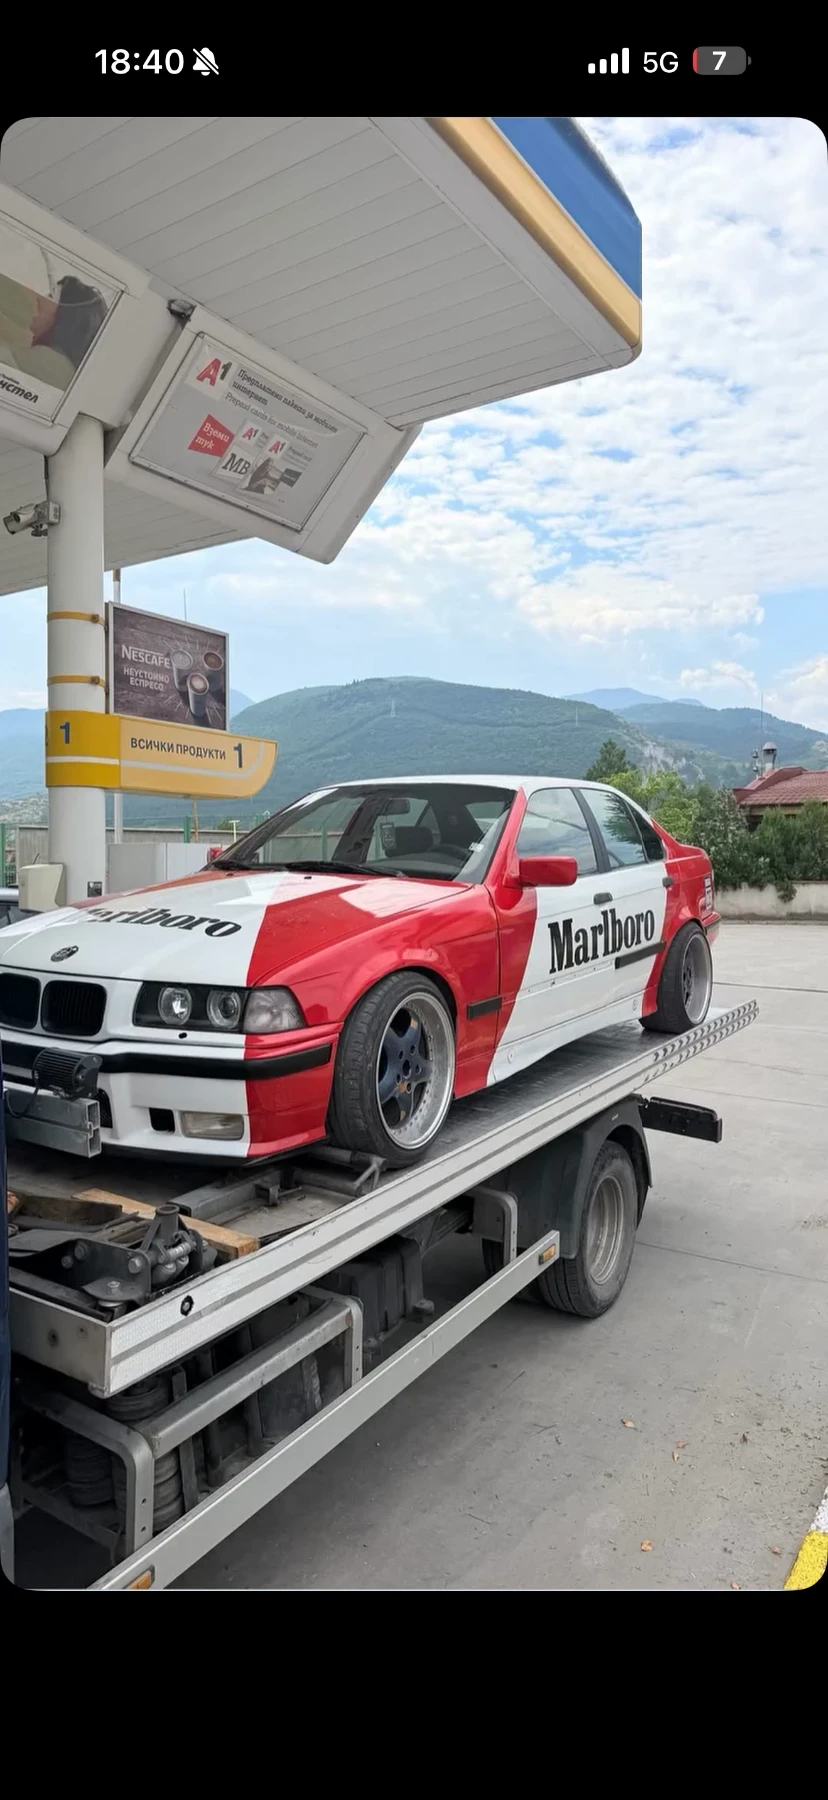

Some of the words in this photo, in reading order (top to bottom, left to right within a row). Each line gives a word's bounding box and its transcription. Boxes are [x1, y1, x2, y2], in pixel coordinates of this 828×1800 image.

[196, 358, 232, 386] A1
[225, 391, 251, 412] Prepaid
[251, 407, 268, 421] cards
[268, 415, 277, 426] for
[195, 436, 215, 450] тук
[203, 422, 229, 443] Вземи
[242, 427, 259, 440] A1
[268, 440, 286, 454] A1
[123, 666, 170, 684] НЕУСТОИМО
[130, 677, 164, 691] ЕСПРЕСО
[60, 722, 70, 744] 1
[130, 737, 174, 753] ВСИЧКИ
[176, 743, 226, 760] ПРОДУКТИ
[233, 743, 242, 768] 1
[547, 908, 655, 974] Marlboro
